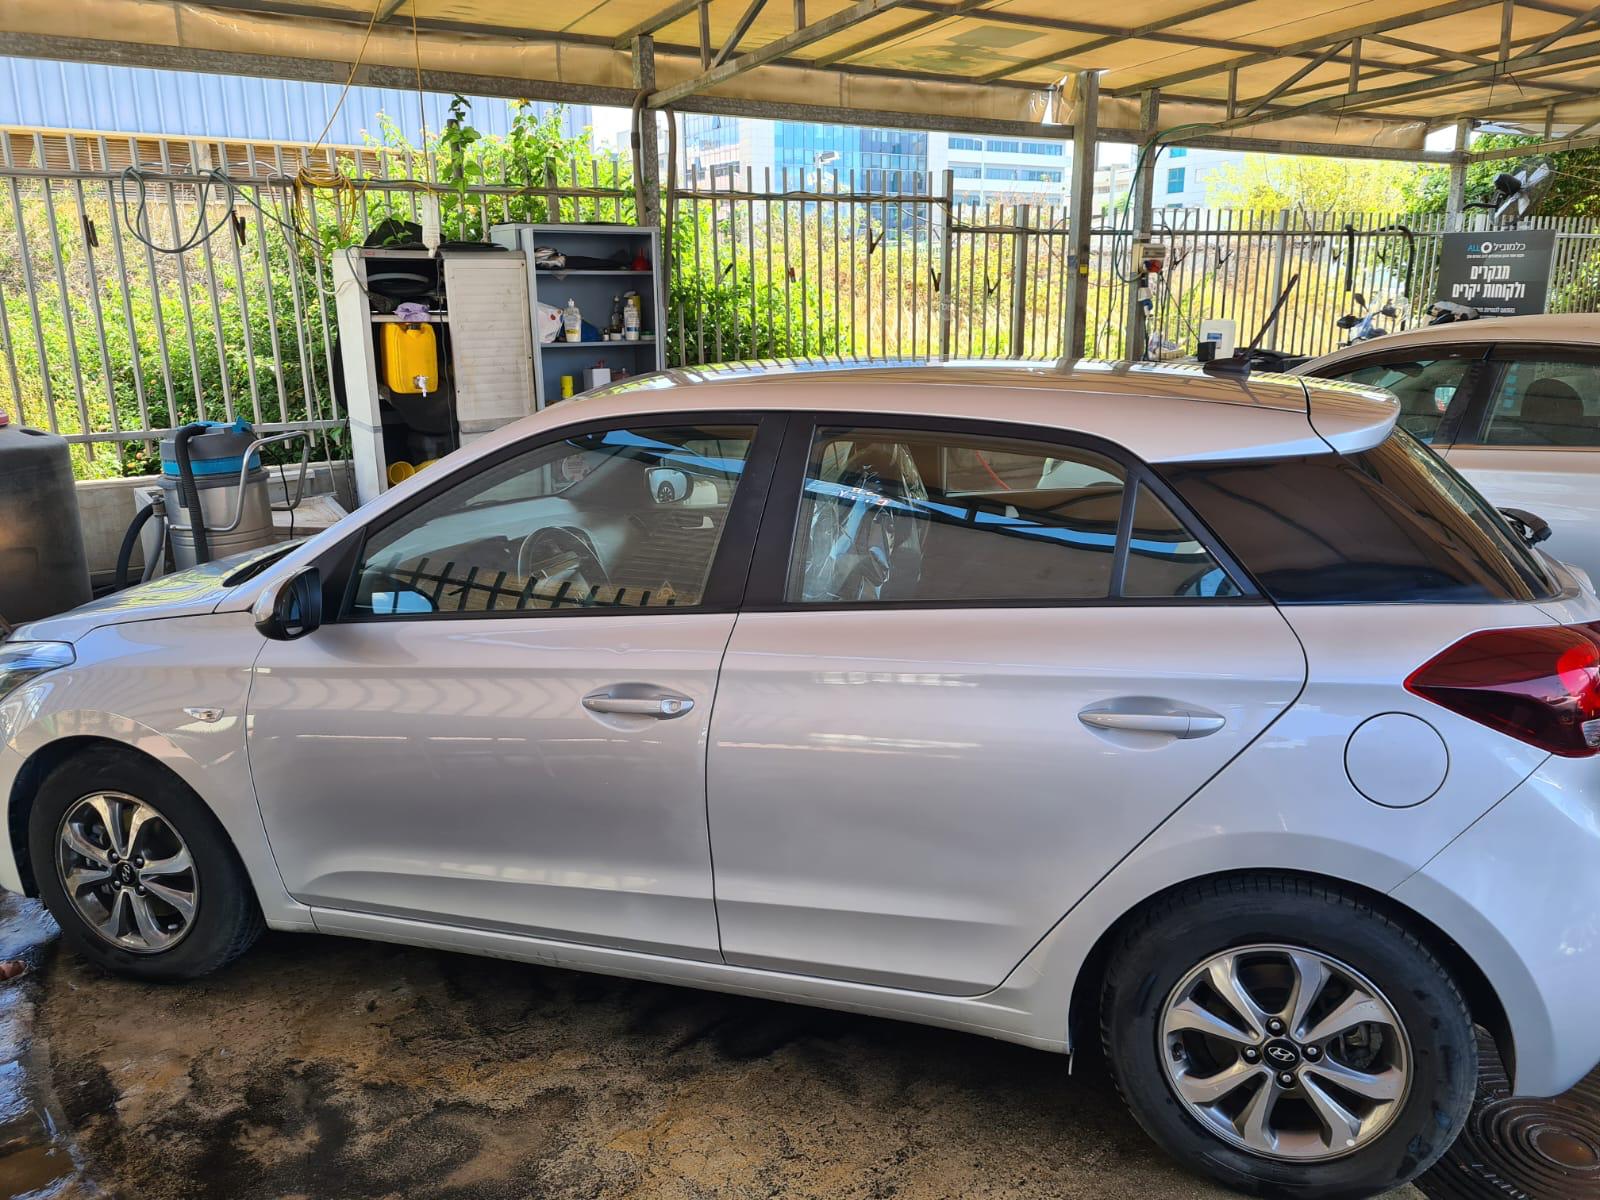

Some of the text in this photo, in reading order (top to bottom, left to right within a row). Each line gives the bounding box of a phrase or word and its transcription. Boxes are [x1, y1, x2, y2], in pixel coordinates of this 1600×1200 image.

[1492, 242, 1526, 251] כלמוביל
[1470, 265, 1510, 283] מבקרים
[1452, 282, 1526, 301] ולקוחות יקרים
